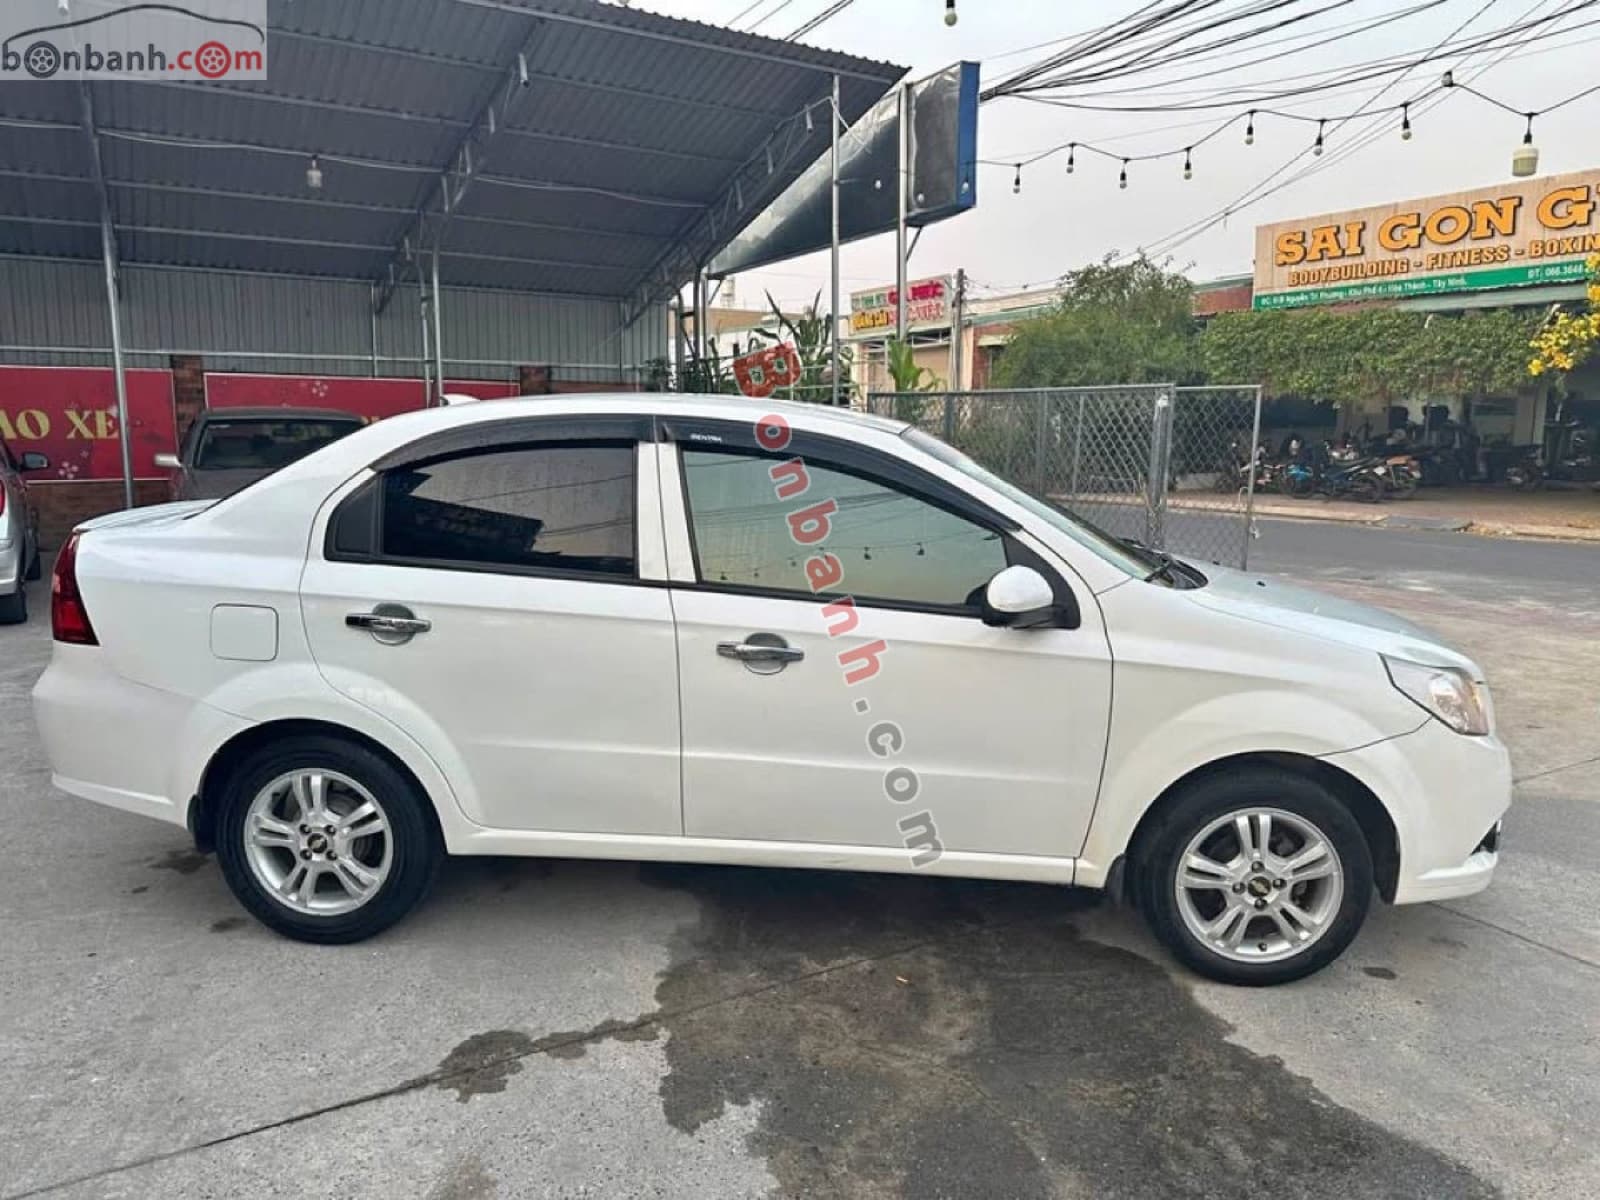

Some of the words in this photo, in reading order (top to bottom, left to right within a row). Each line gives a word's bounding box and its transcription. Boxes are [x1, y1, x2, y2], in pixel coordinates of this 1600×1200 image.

[1275, 221, 1366, 266] SAI
[1379, 196, 1522, 251] GON
[1537, 184, 1600, 230] G
[1288, 259, 1409, 287] BODYBUILDING
[1426, 244, 1510, 271] FITNESS
[64, 409, 119, 439] XE
